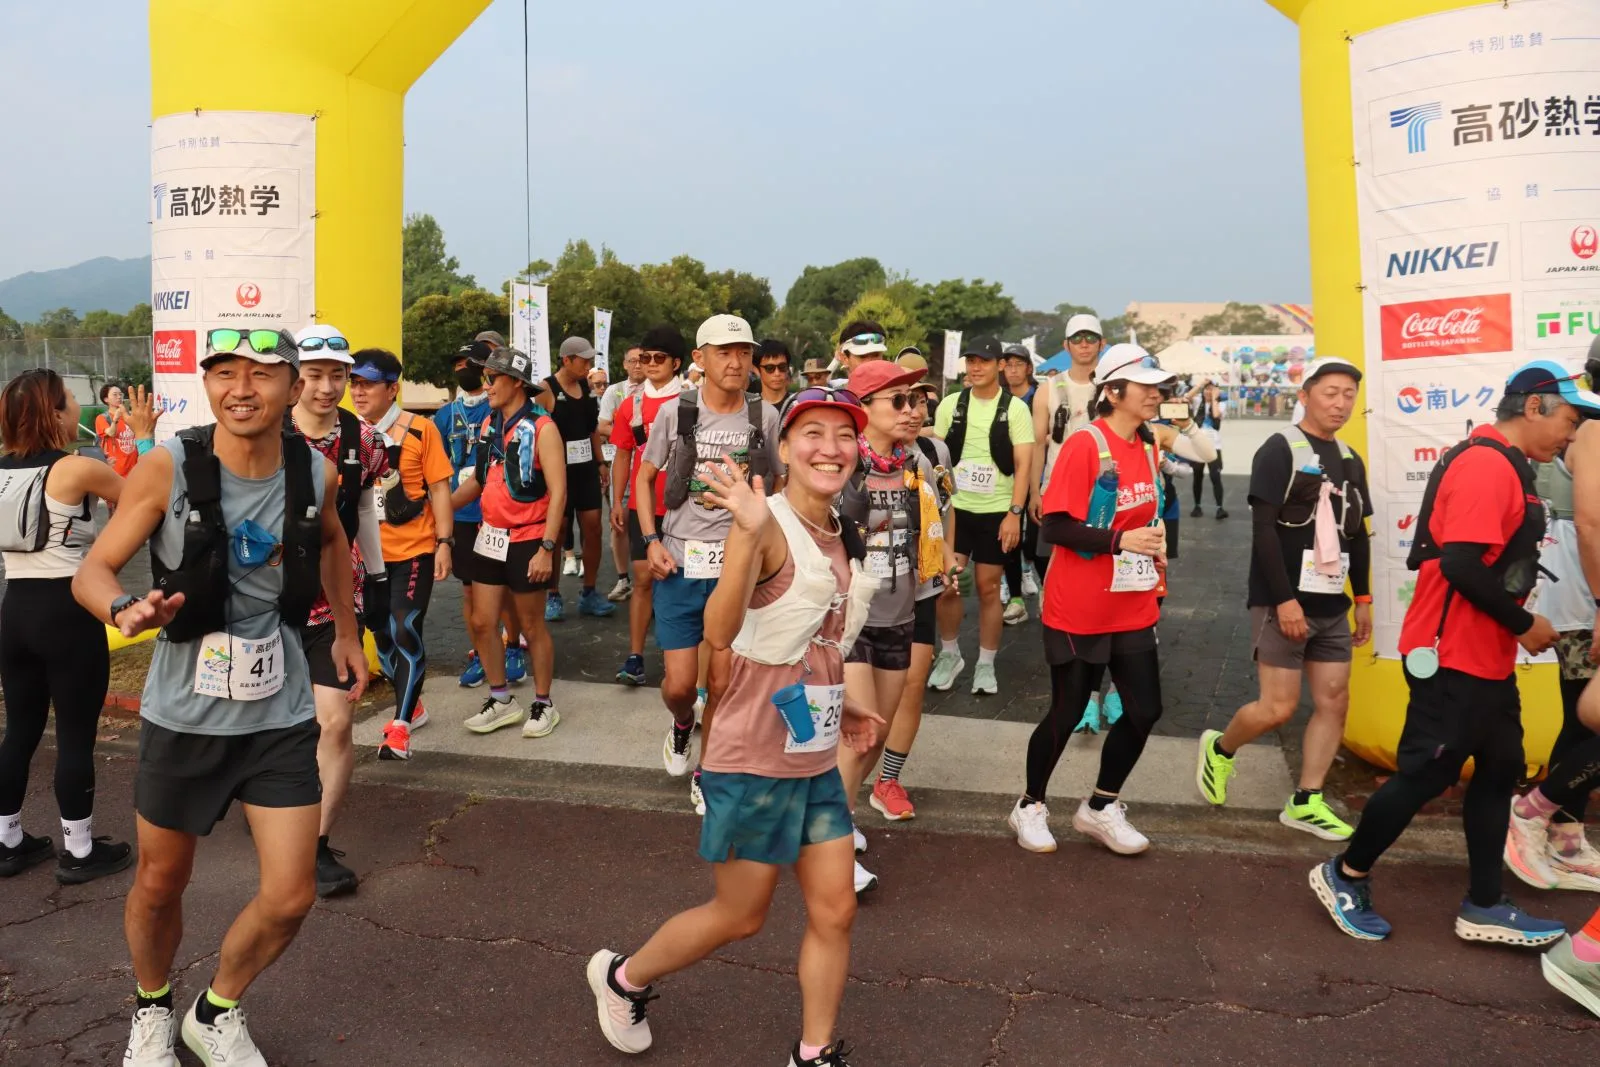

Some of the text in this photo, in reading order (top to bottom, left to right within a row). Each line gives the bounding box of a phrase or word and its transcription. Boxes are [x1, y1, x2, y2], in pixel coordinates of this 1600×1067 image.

[170, 185, 280, 217] 高砂熱学
[1386, 241, 1500, 278] NIKKEI
[1401, 306, 1484, 339] Coca-Cola
[1426, 386, 1494, 410] 南レク
[971, 472, 992, 484] 507
[485, 534, 504, 548] 310
[250, 653, 274, 677] 41
